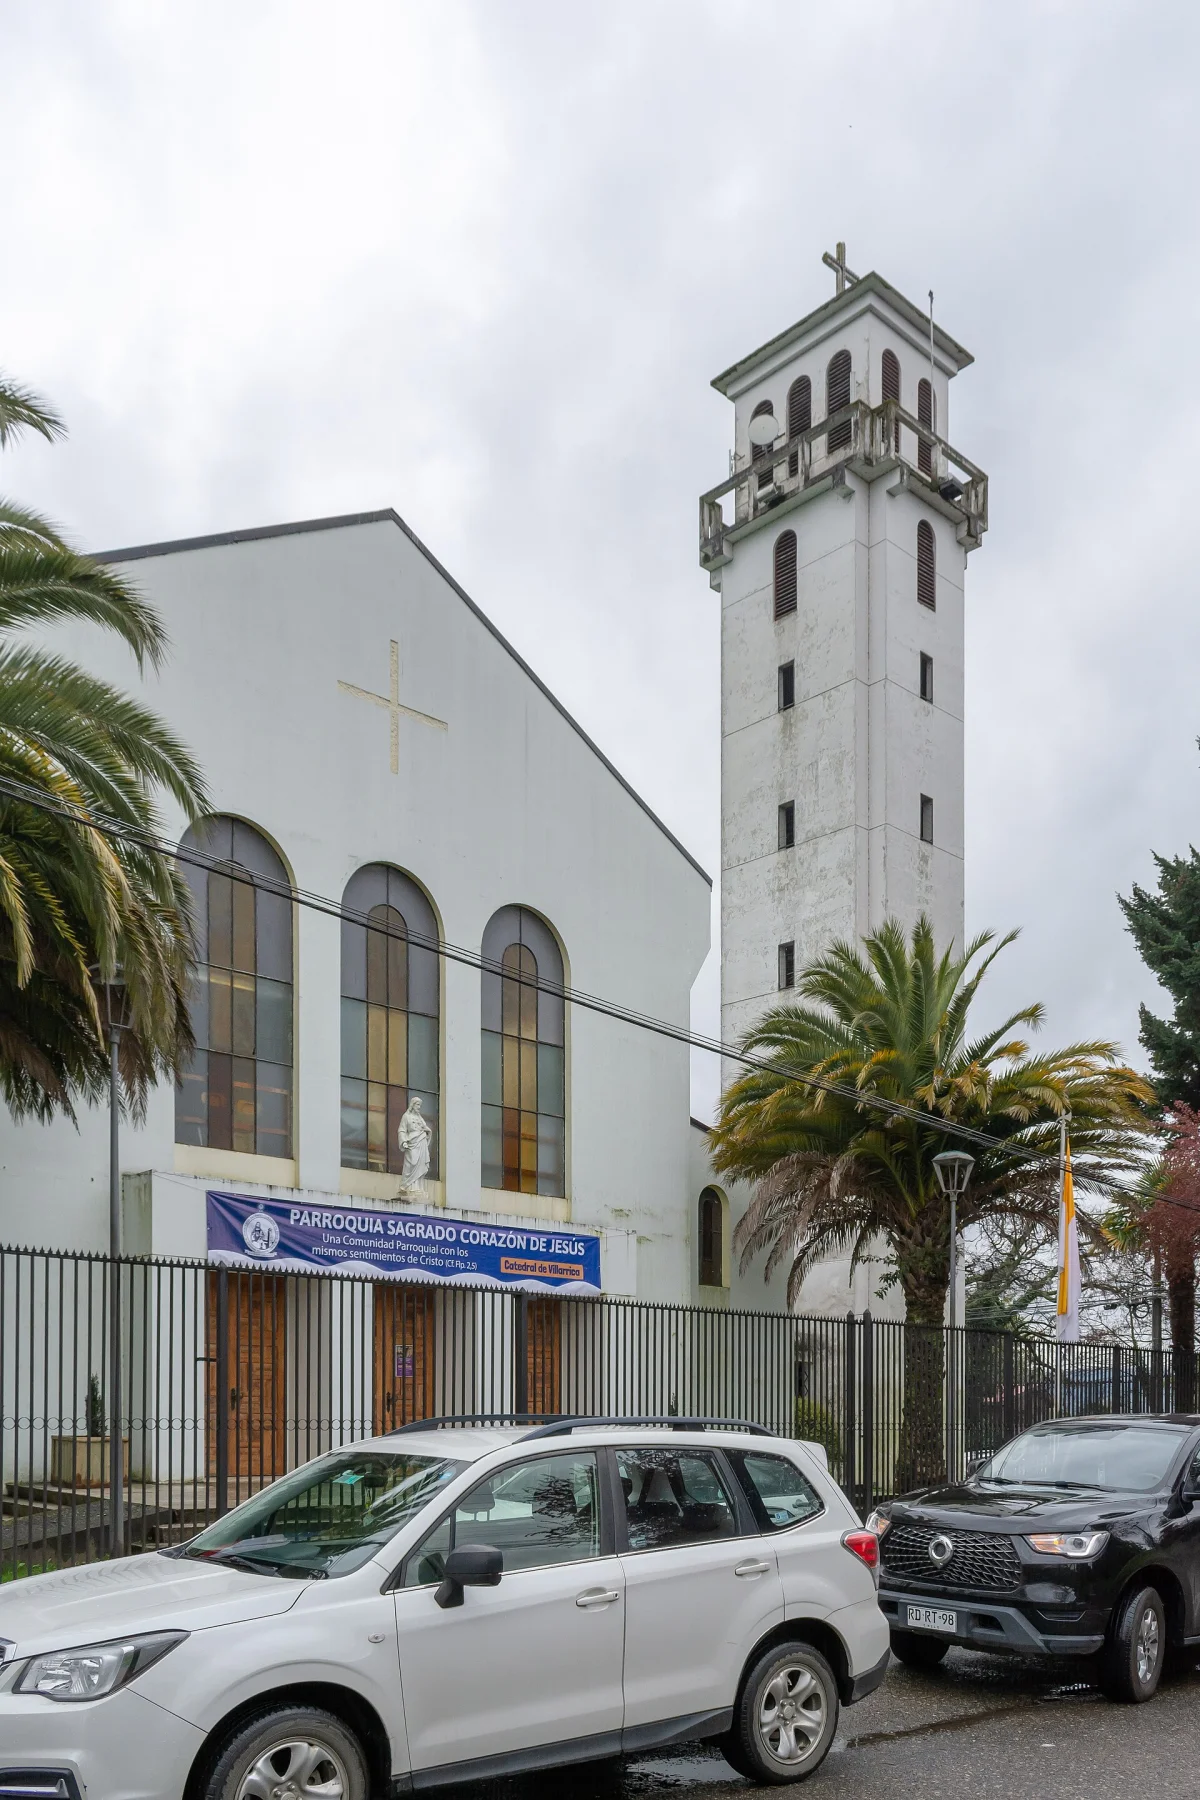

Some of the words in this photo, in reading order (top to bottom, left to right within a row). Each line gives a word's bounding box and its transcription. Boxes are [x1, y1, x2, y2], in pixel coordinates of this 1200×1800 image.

[290, 1209, 384, 1234] PARROQUIA
[387, 1219, 457, 1242] SAGRADO
[460, 1230, 527, 1250] CORAZÓN
[530, 1238, 547, 1252] DE
[549, 1237, 586, 1256] JESÚS
[322, 1233, 341, 1245] Una
[343, 1235, 394, 1249] Comunidad
[396, 1241, 439, 1254] Parroquial
[440, 1247, 455, 1256] con
[457, 1247, 469, 1257] los
[312, 1246, 348, 1258] mismos
[349, 1248, 406, 1263] sentimientos
[407, 1251, 418, 1264] de
[419, 1254, 444, 1267] Cristo
[504, 1259, 537, 1273] Catedral
[538, 1263, 547, 1274] de
[548, 1264, 581, 1277] Villarrica
